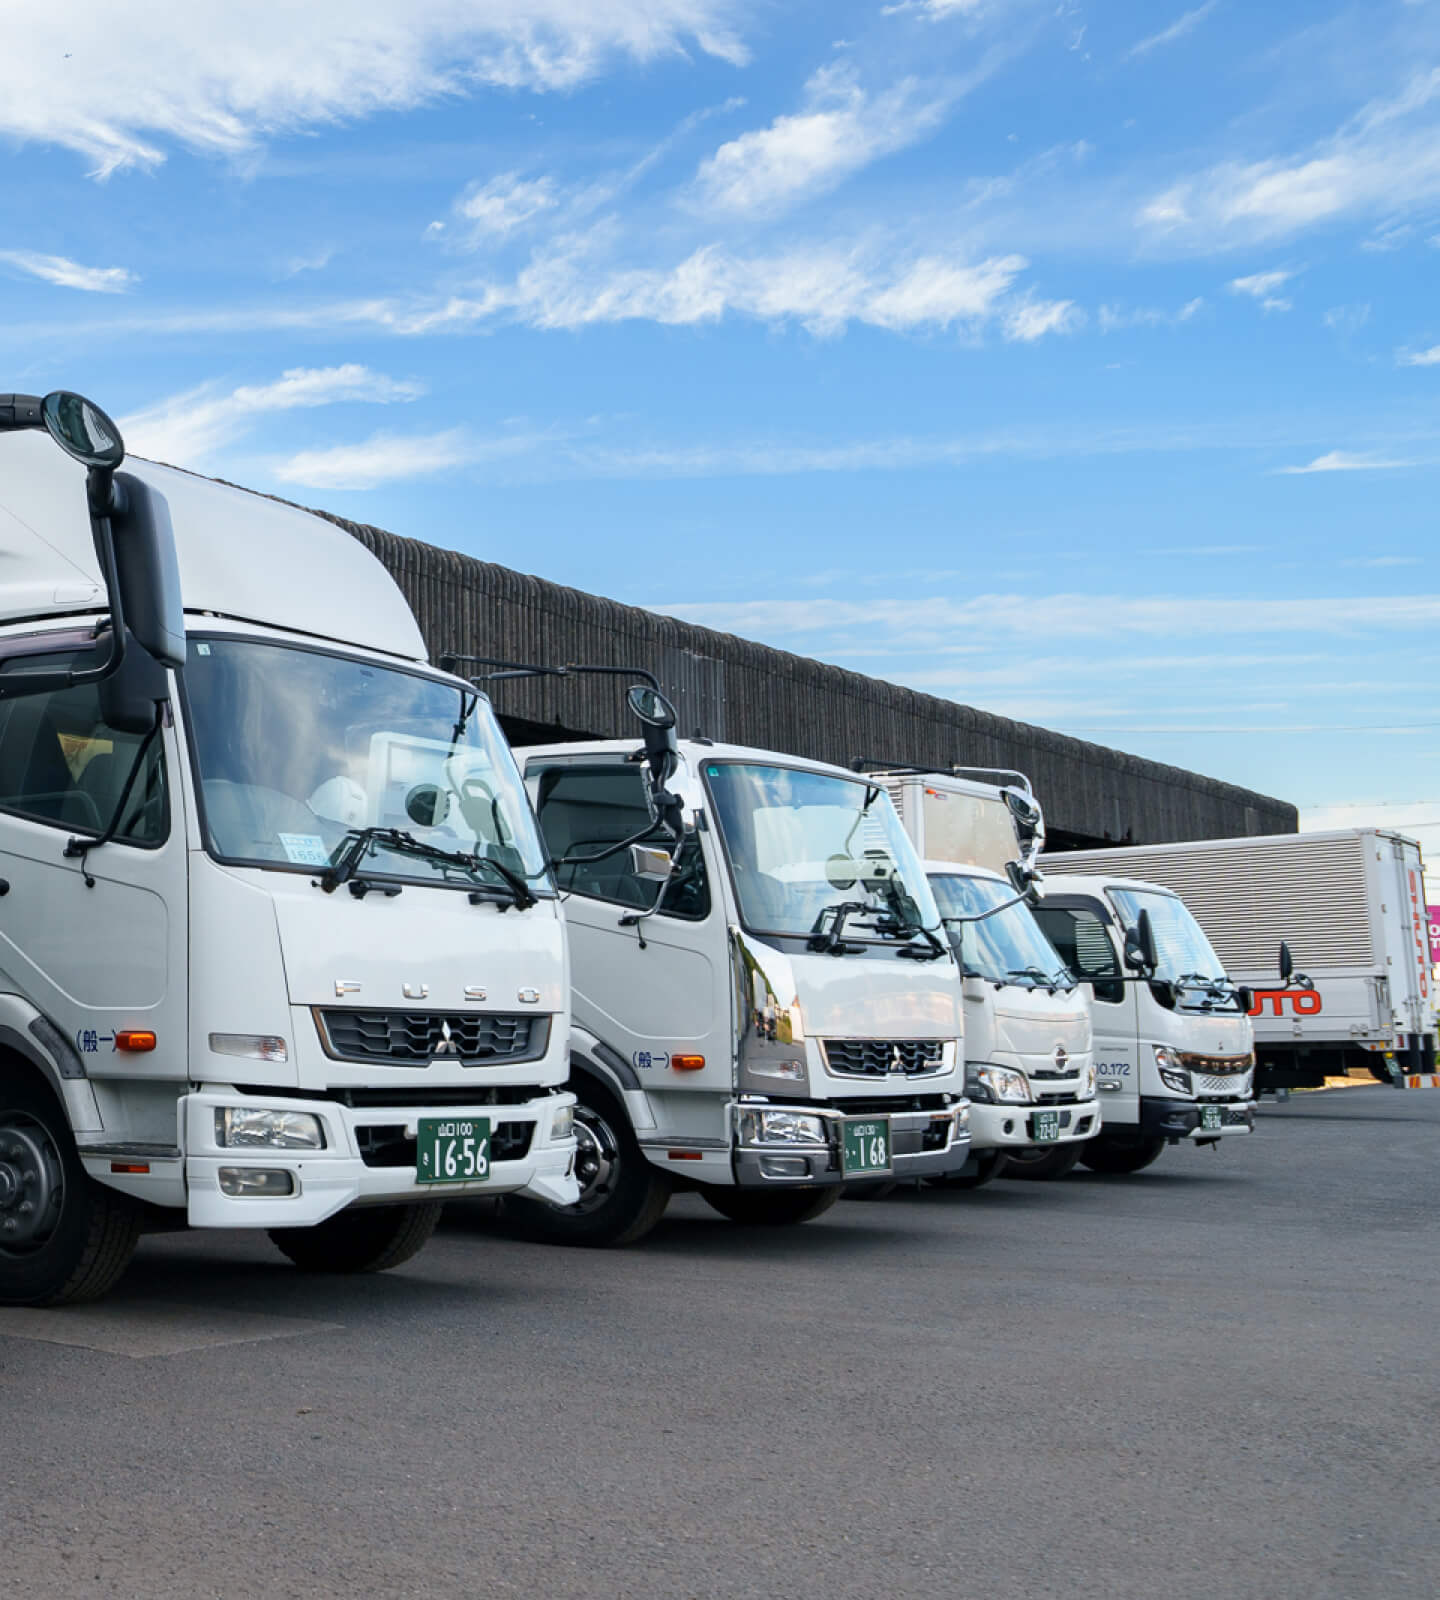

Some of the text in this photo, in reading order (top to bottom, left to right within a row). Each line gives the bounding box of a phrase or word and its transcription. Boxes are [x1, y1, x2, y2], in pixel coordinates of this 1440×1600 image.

[335, 979, 540, 1003] FUSO
[438, 1122, 472, 1136] 山口 100
